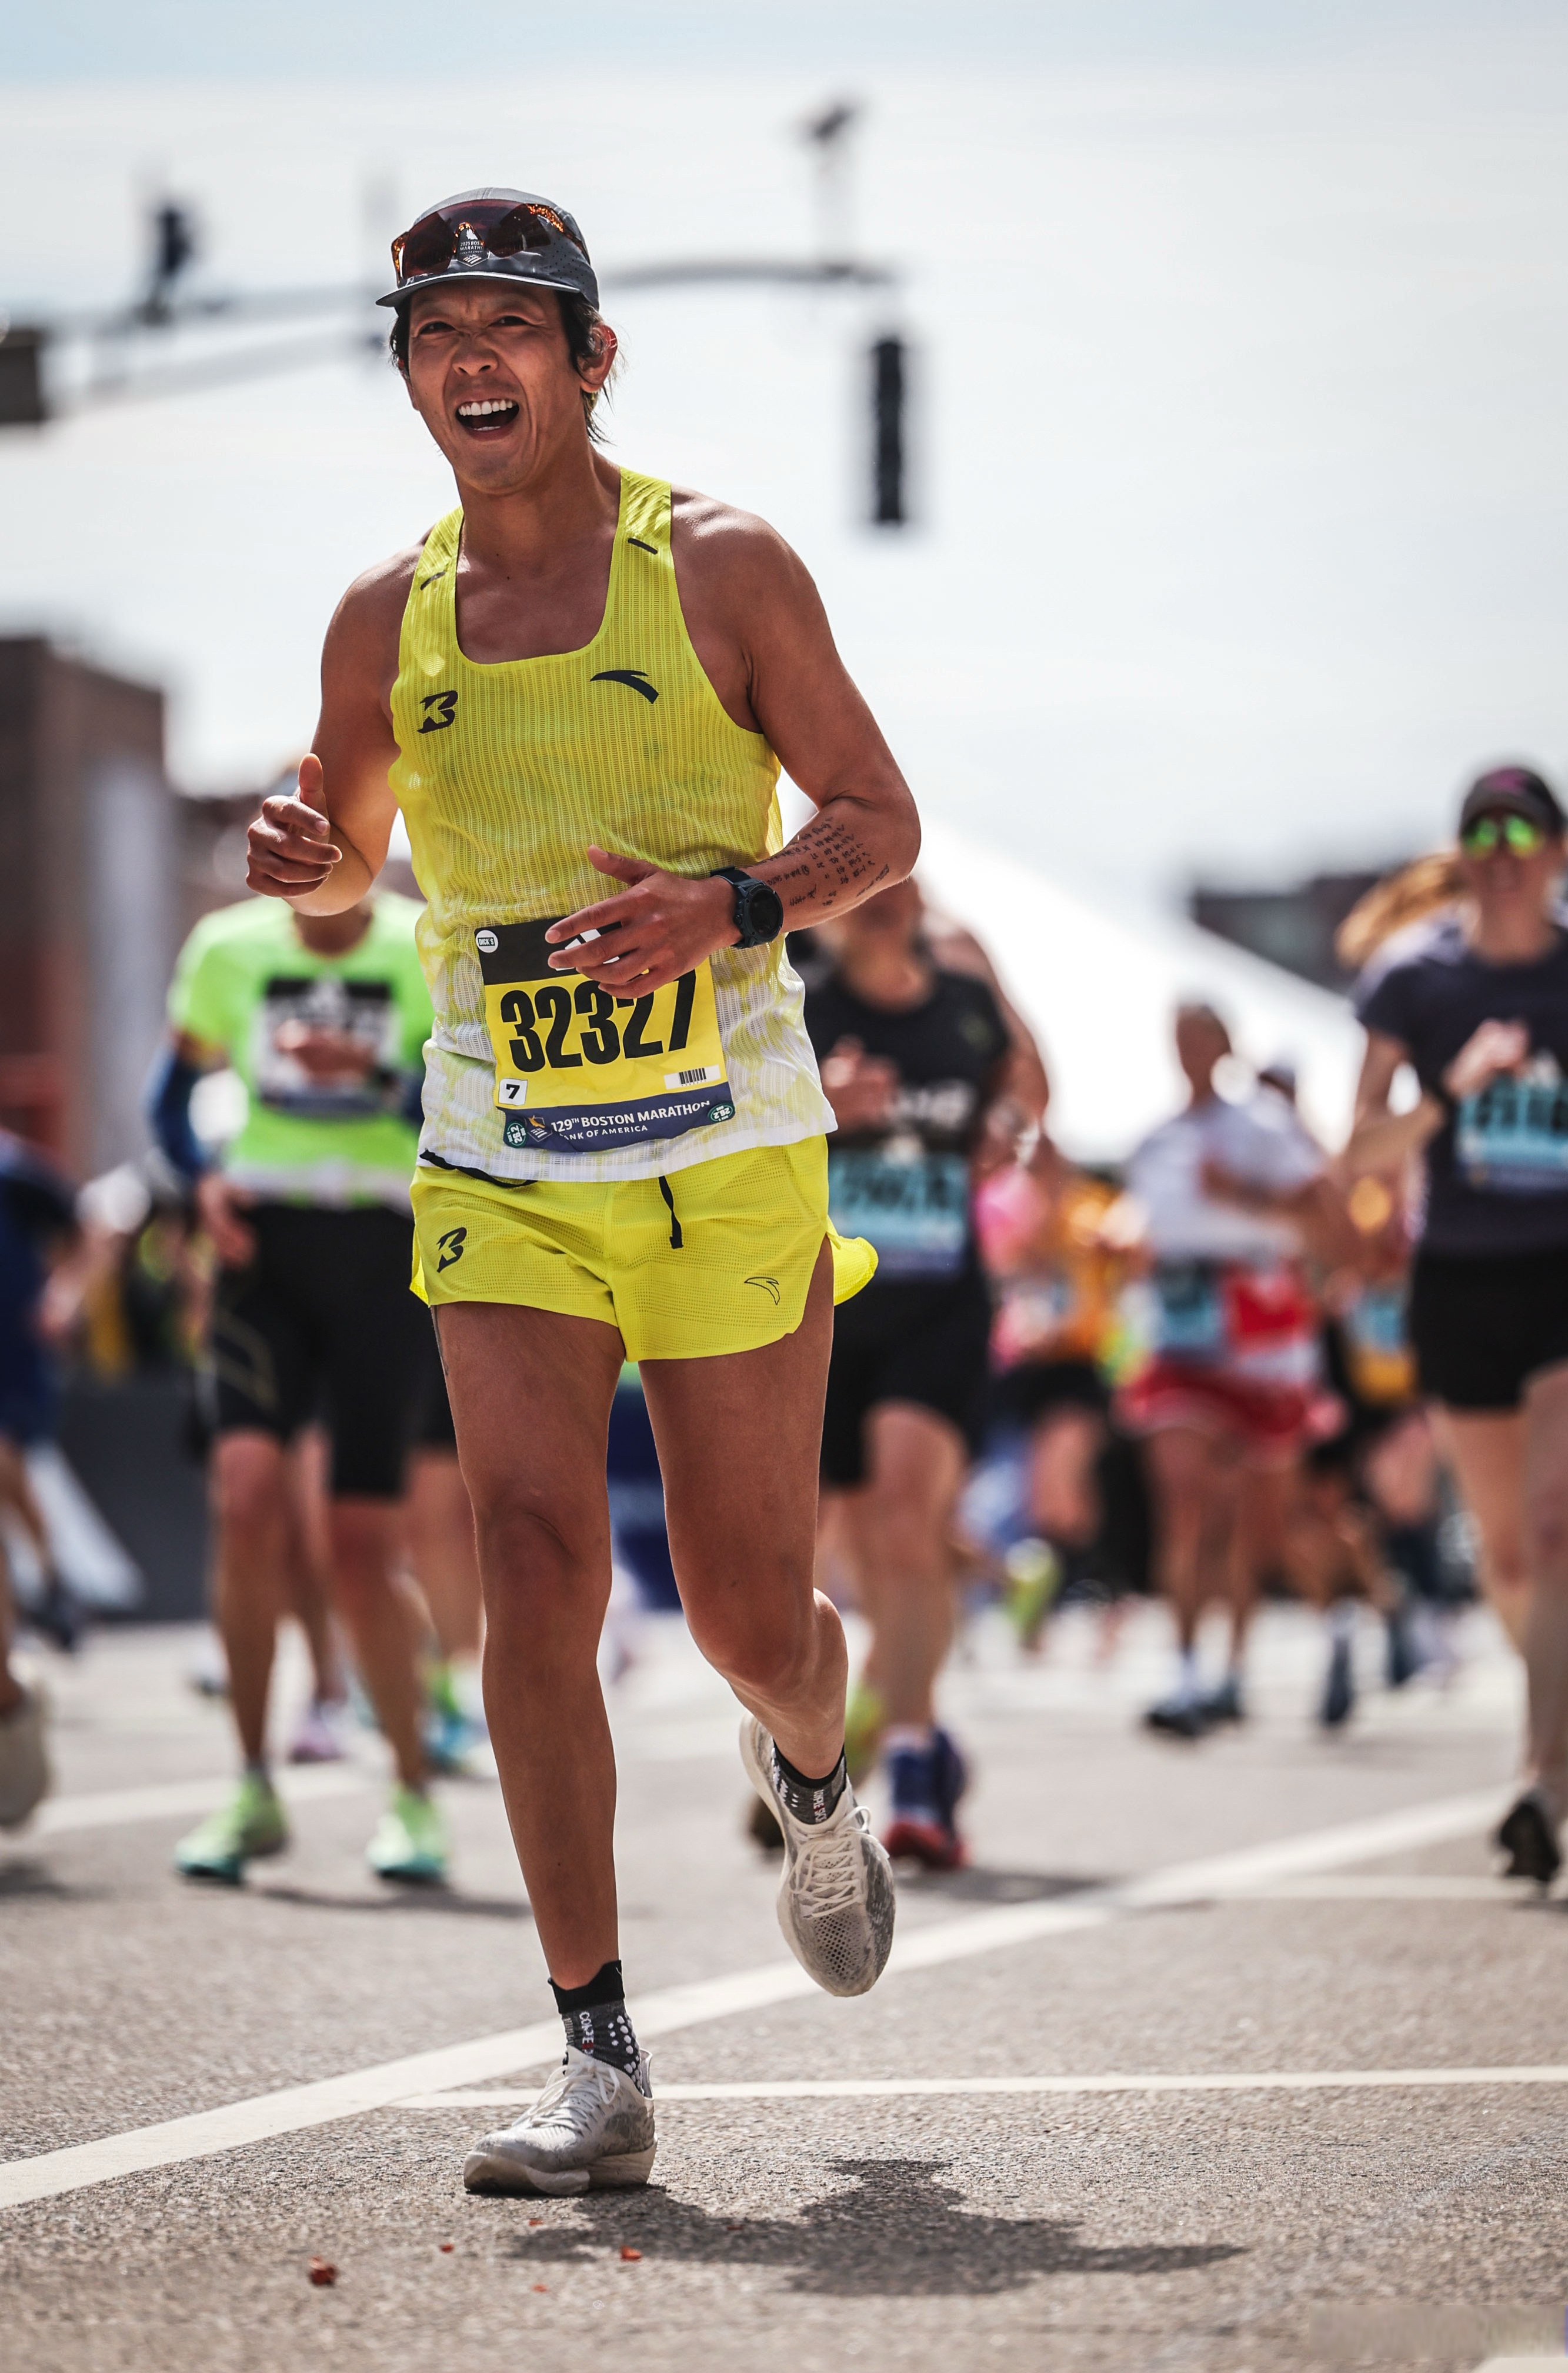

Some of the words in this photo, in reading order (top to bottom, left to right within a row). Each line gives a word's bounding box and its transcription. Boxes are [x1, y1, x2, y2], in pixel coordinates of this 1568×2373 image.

[501, 969, 696, 1072] 32327
[506, 1083, 521, 1099] 7
[551, 1118, 579, 1132] 129TH
[581, 1113, 635, 1127] BOSTON
[637, 1100, 710, 1122] MARATHON
[510, 1125, 523, 1144] 26.2
[602, 1125, 648, 1135] AMERICA
